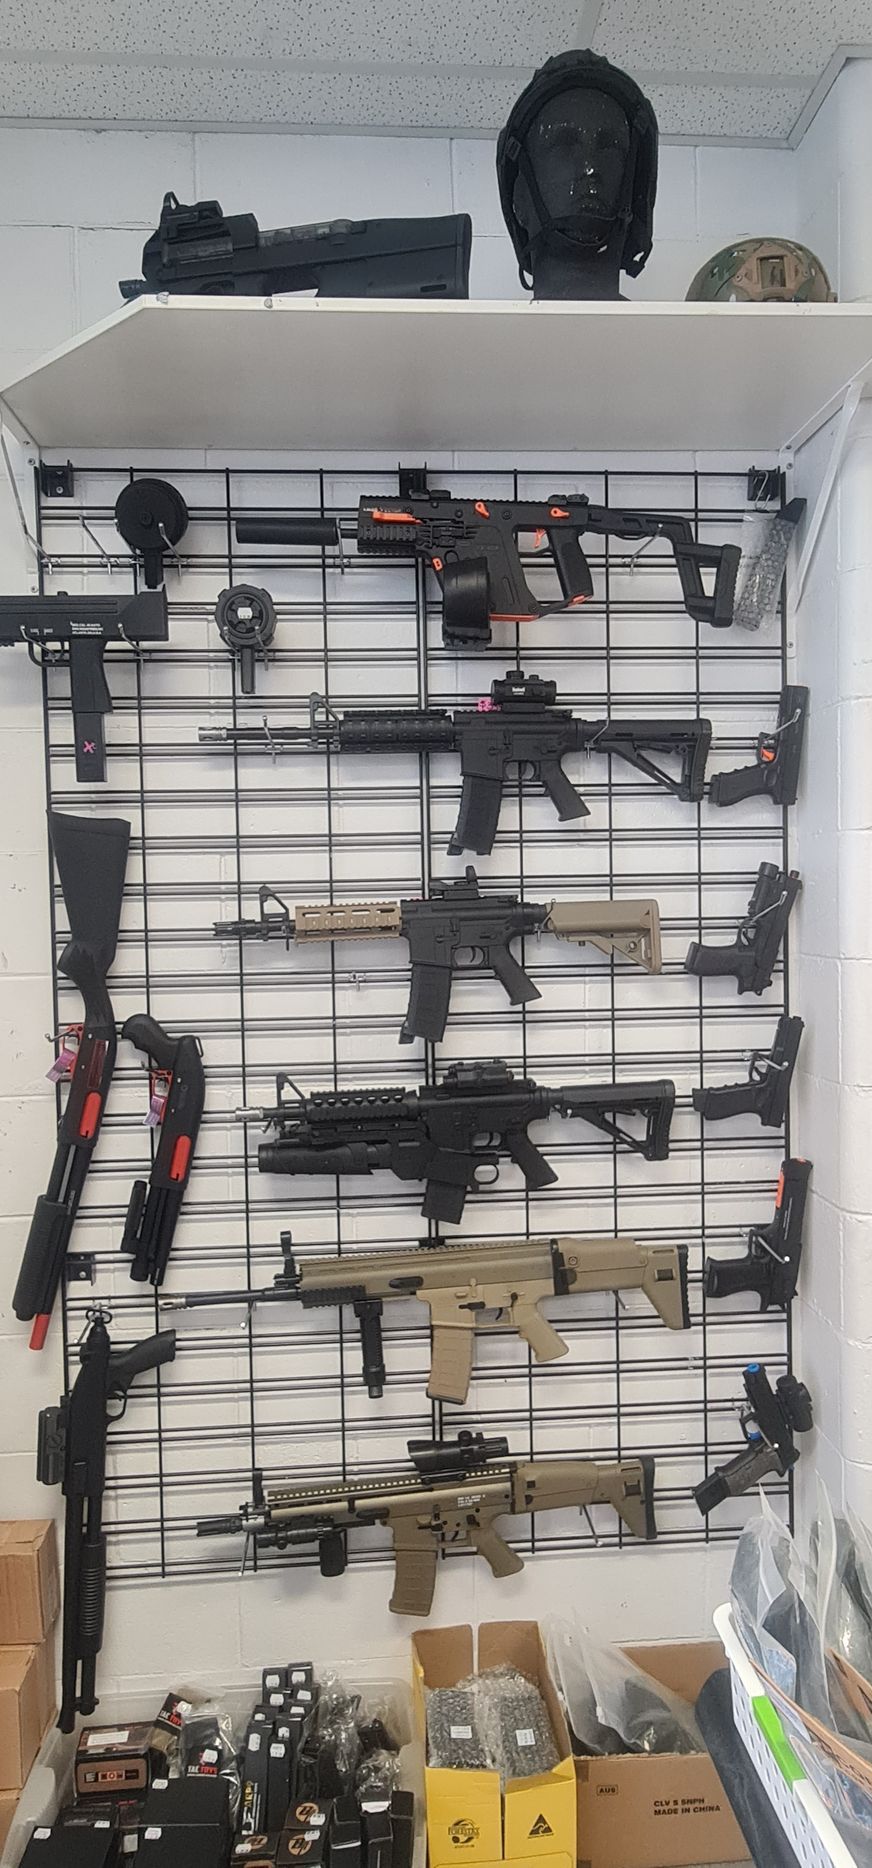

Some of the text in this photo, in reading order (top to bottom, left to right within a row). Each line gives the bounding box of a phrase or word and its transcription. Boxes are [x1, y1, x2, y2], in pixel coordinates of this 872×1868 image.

[653, 1799, 671, 1807] CLV
[653, 1805, 721, 1816] MADE IN CHINA
